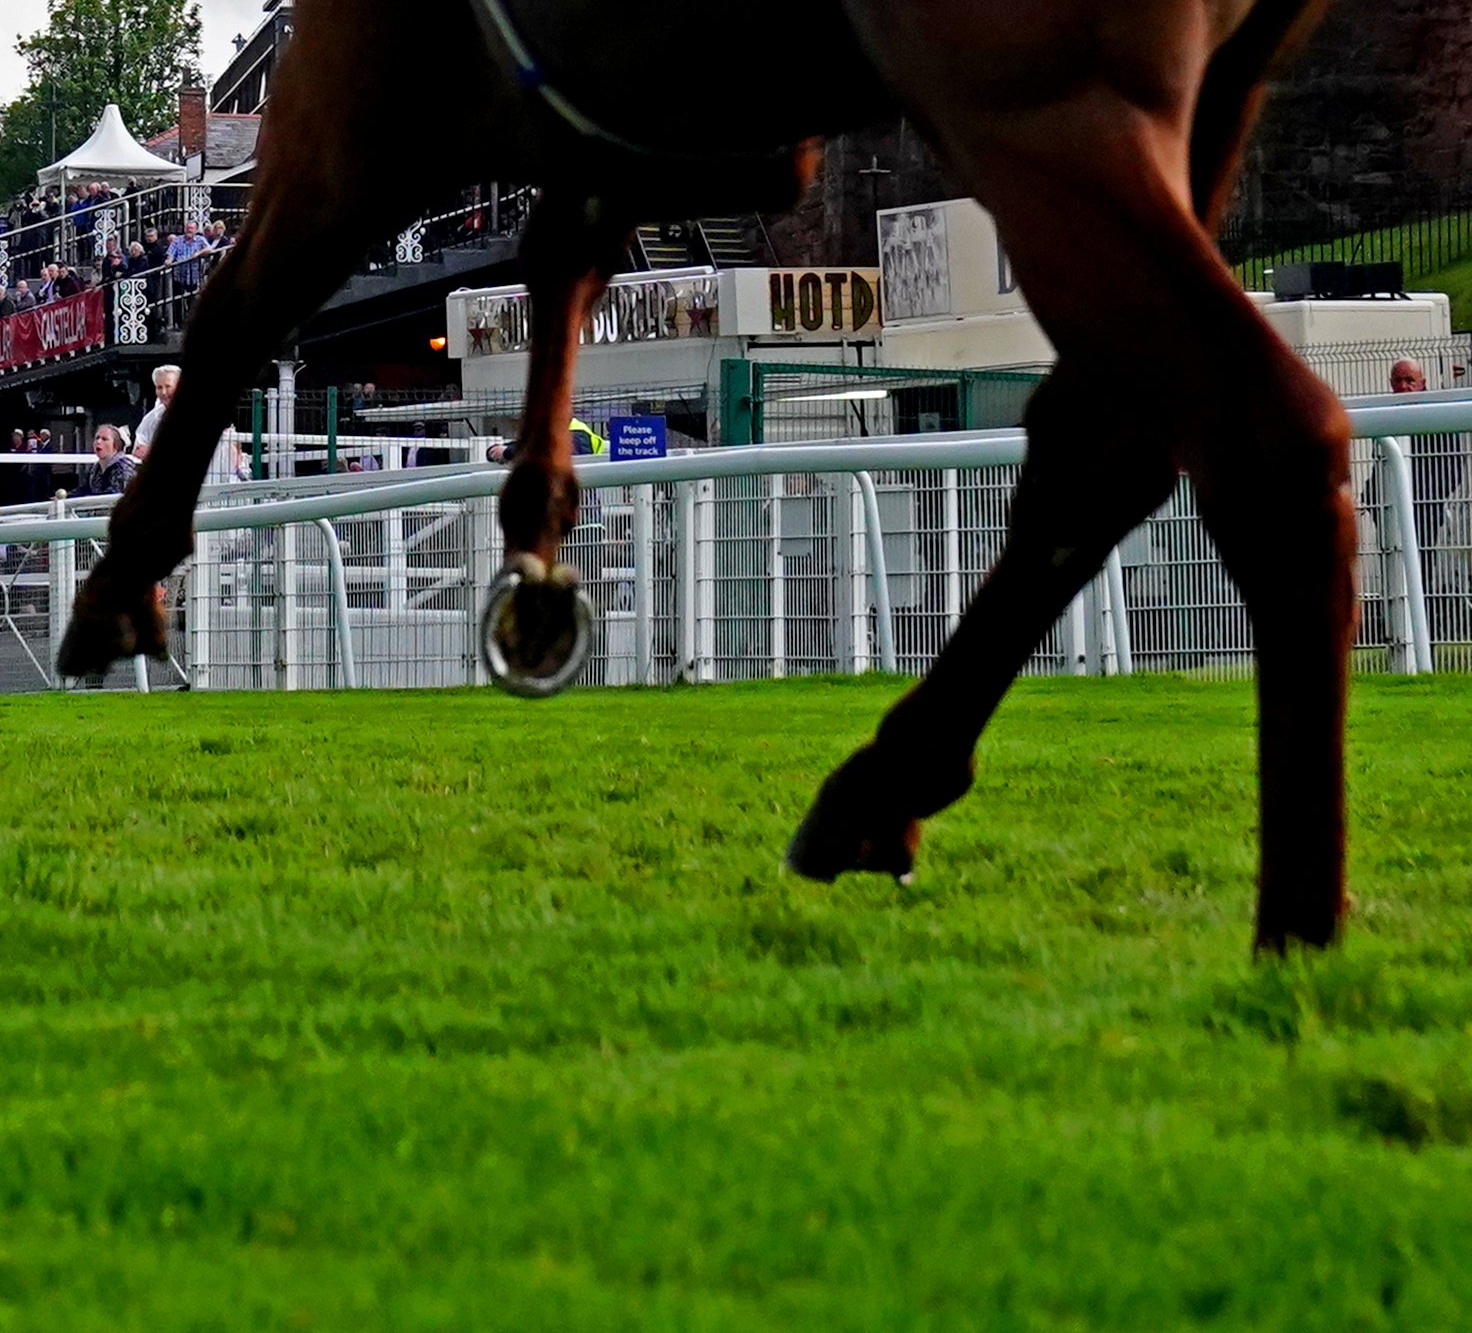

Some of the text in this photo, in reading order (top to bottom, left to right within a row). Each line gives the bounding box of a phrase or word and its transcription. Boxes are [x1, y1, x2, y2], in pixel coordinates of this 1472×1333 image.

[769, 270, 882, 332] HOTD
[622, 425, 653, 434] Please
[618, 436, 657, 446] keep off
[617, 447, 659, 455] the track
